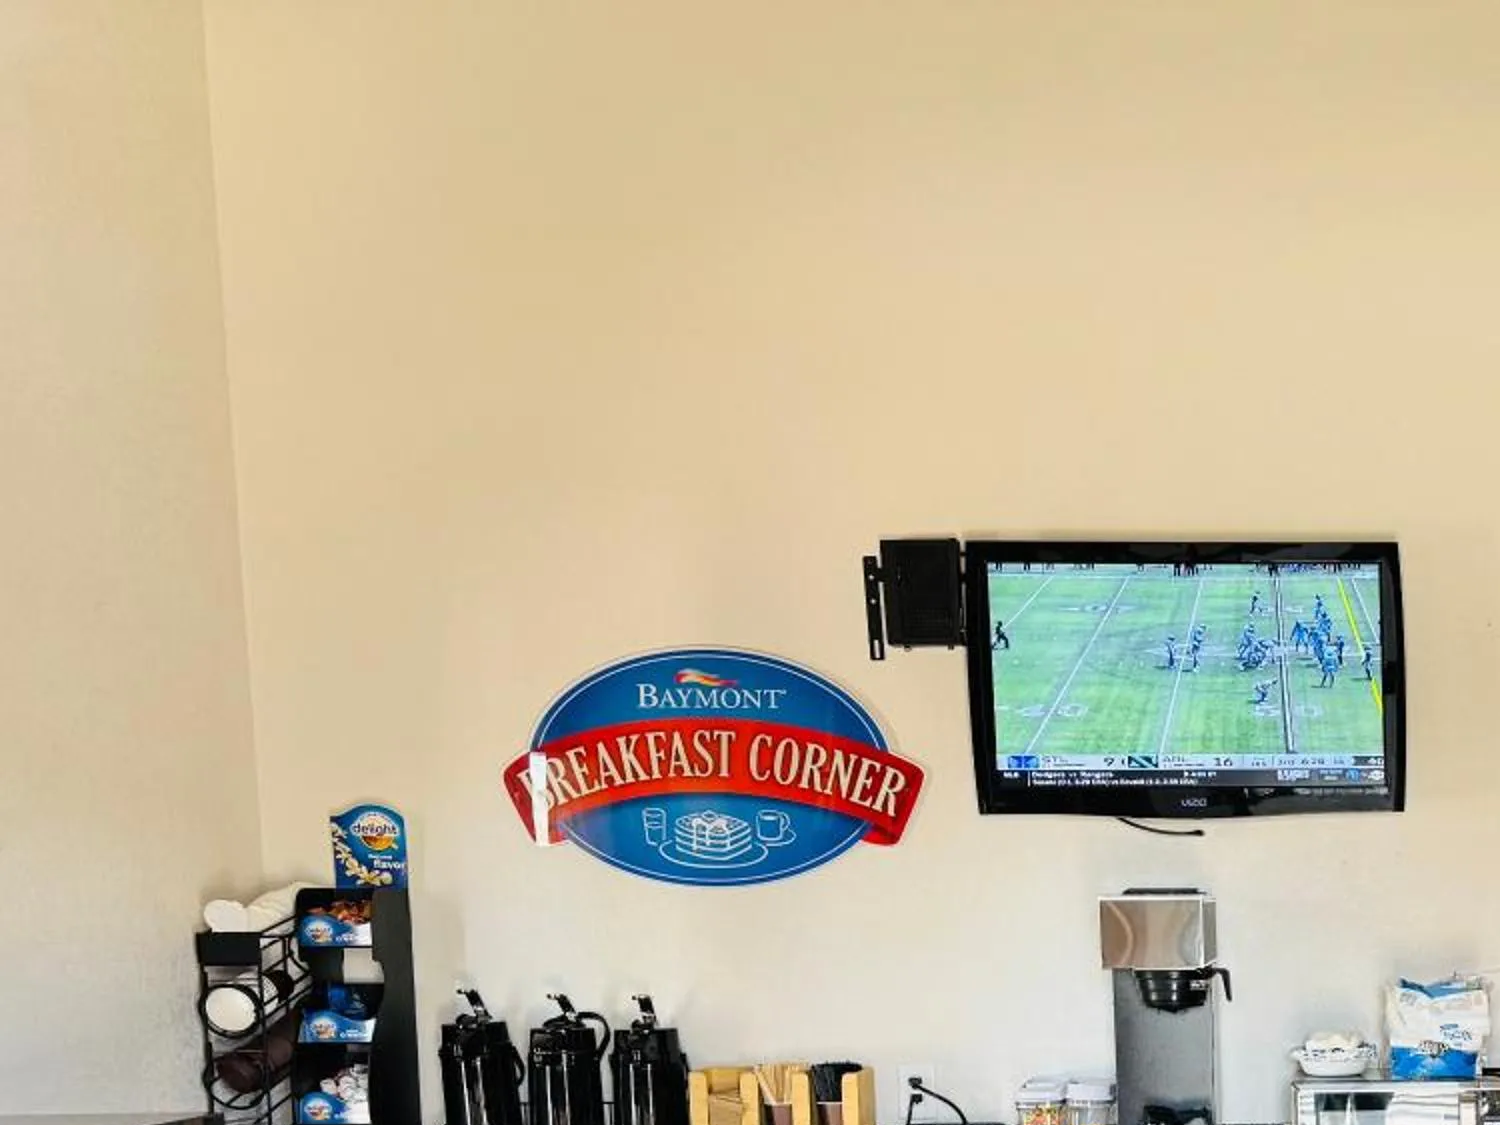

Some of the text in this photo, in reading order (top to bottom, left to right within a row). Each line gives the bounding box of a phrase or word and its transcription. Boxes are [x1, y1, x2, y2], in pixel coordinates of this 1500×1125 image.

[636, 683, 782, 709] BAYMONT
[749, 733, 906, 818] CORNER
[352, 823, 398, 836] delight
